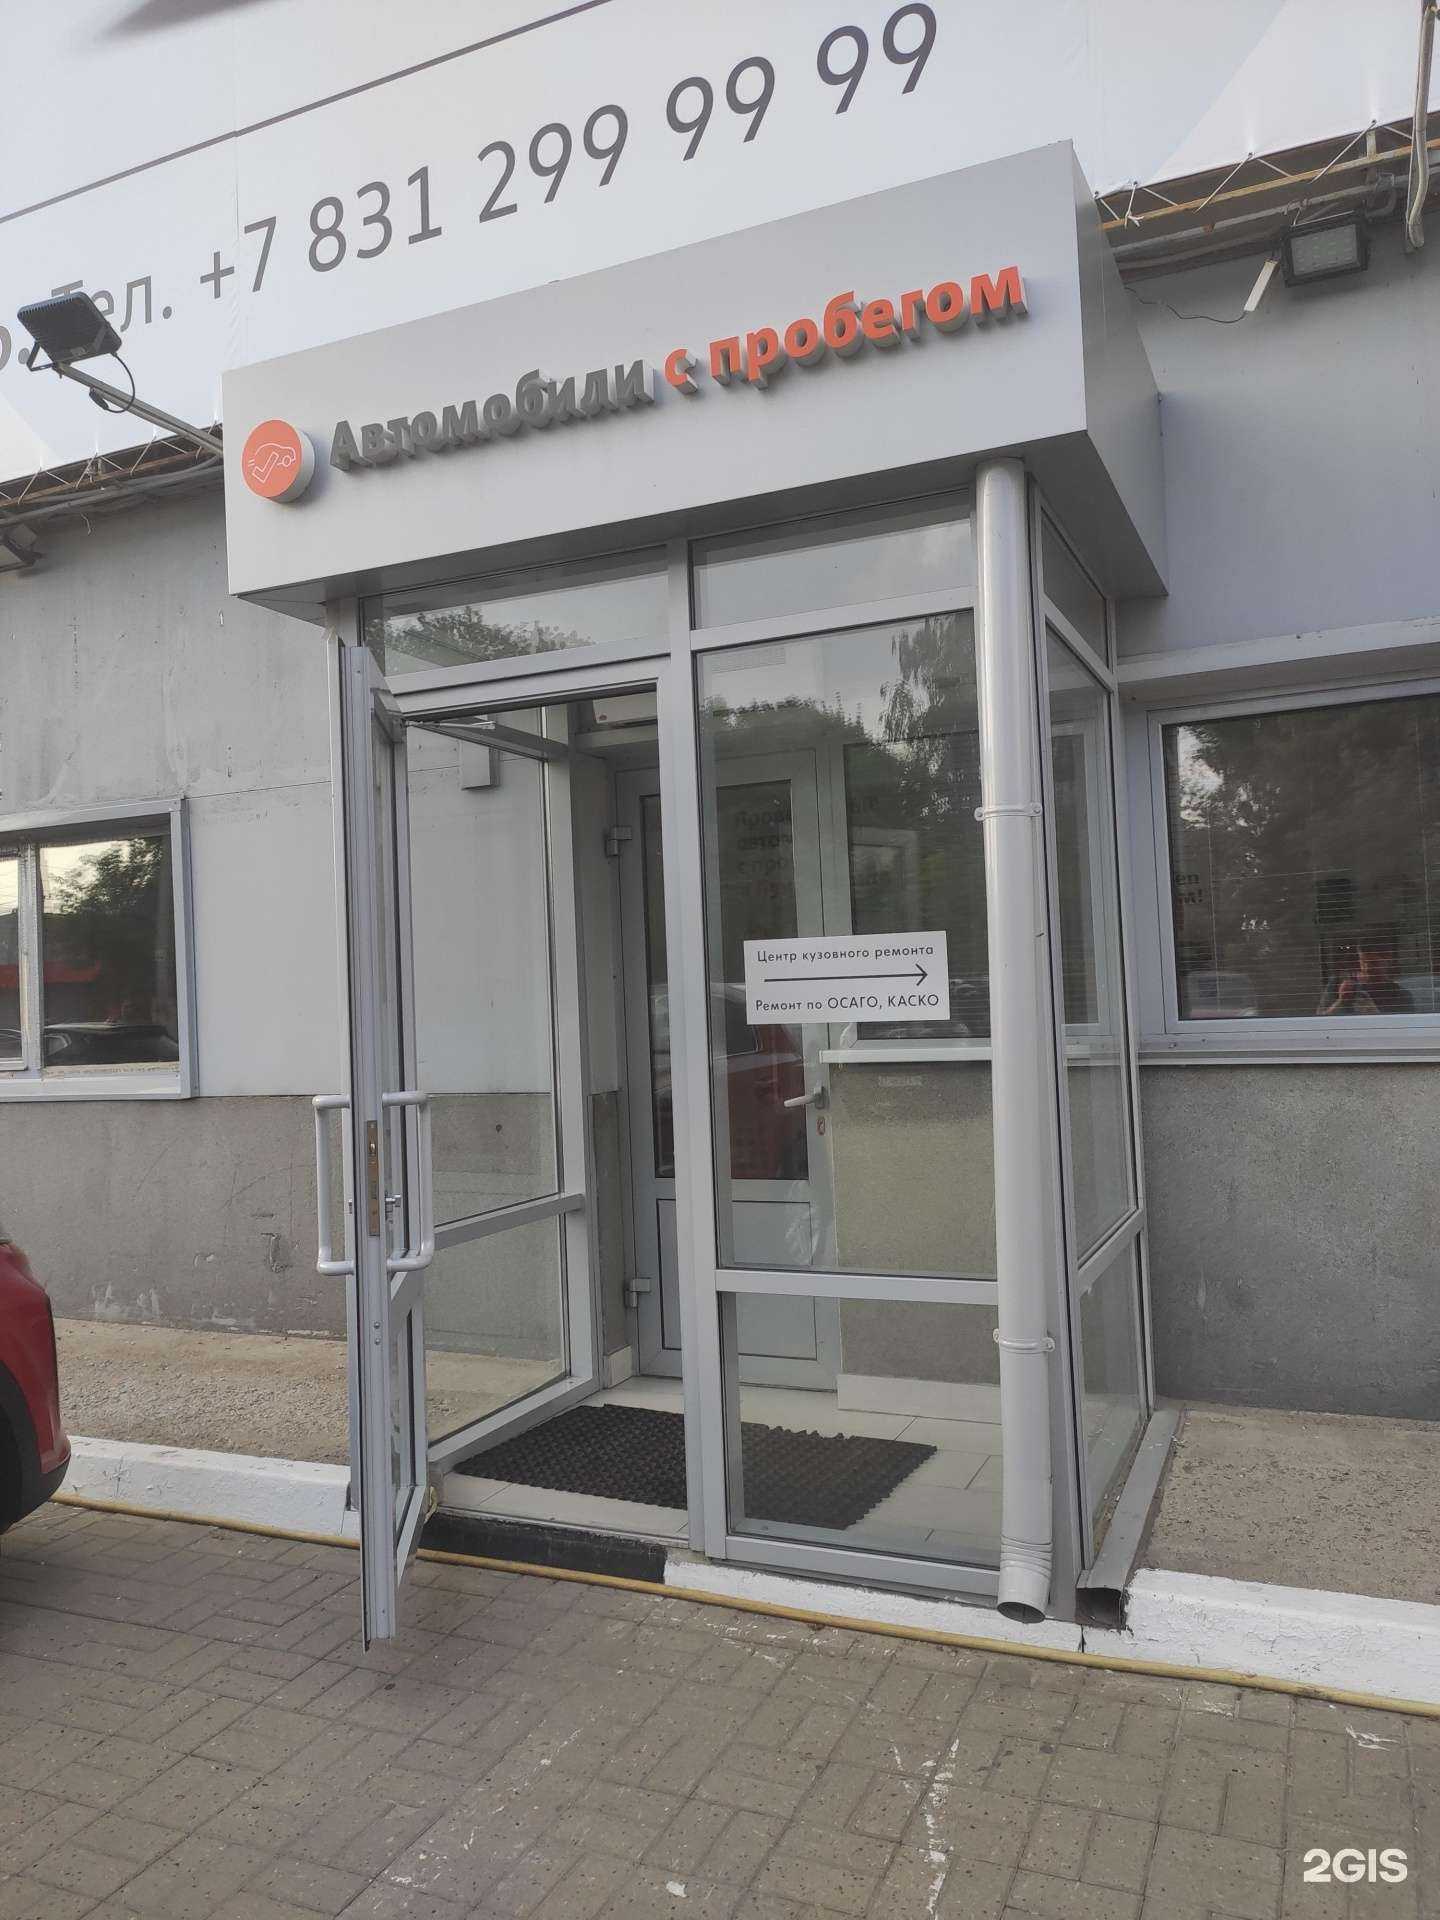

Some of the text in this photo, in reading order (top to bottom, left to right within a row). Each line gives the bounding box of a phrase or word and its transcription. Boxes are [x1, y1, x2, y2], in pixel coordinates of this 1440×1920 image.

[200, 216, 277, 298] +7
[307, 165, 442, 273] 831
[477, 104, 629, 224] 299
[665, 56, 776, 161] 99
[815, 3, 937, 115] 99
[330, 265, 1025, 471] Автомобили с пробегом
[755, 994, 939, 1011] Ремонт по ОСАГО, КАСКО
[757, 945, 934, 963] Центр кузовного ремонта
